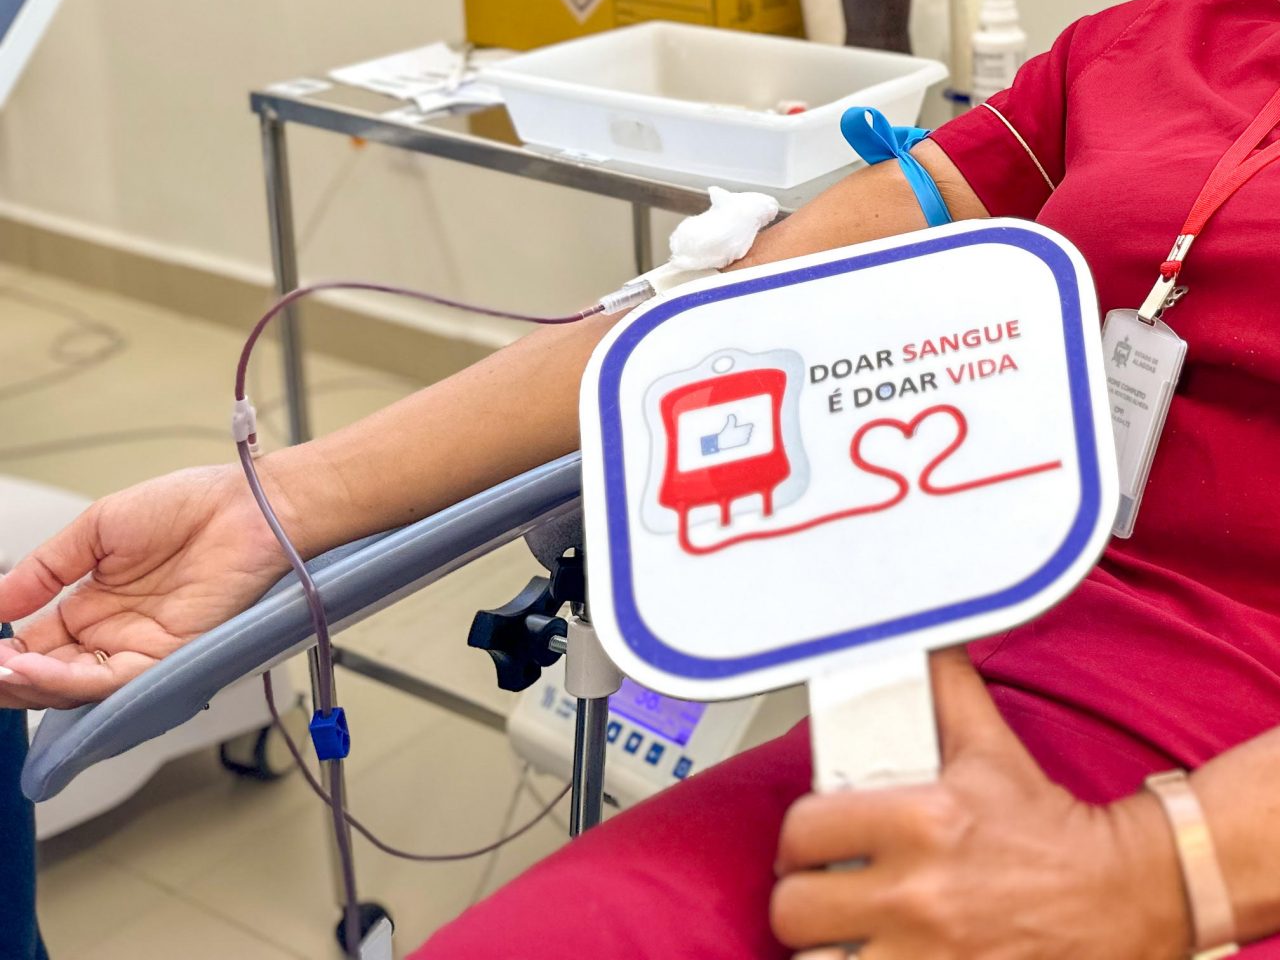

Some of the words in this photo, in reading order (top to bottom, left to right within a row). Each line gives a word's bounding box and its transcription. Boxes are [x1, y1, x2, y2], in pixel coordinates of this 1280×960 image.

[809, 349, 894, 384] DOAR
[902, 319, 1021, 363] SANGUE
[828, 388, 843, 413] É
[853, 372, 938, 408] DOAR
[945, 354, 1018, 385] VIDA
